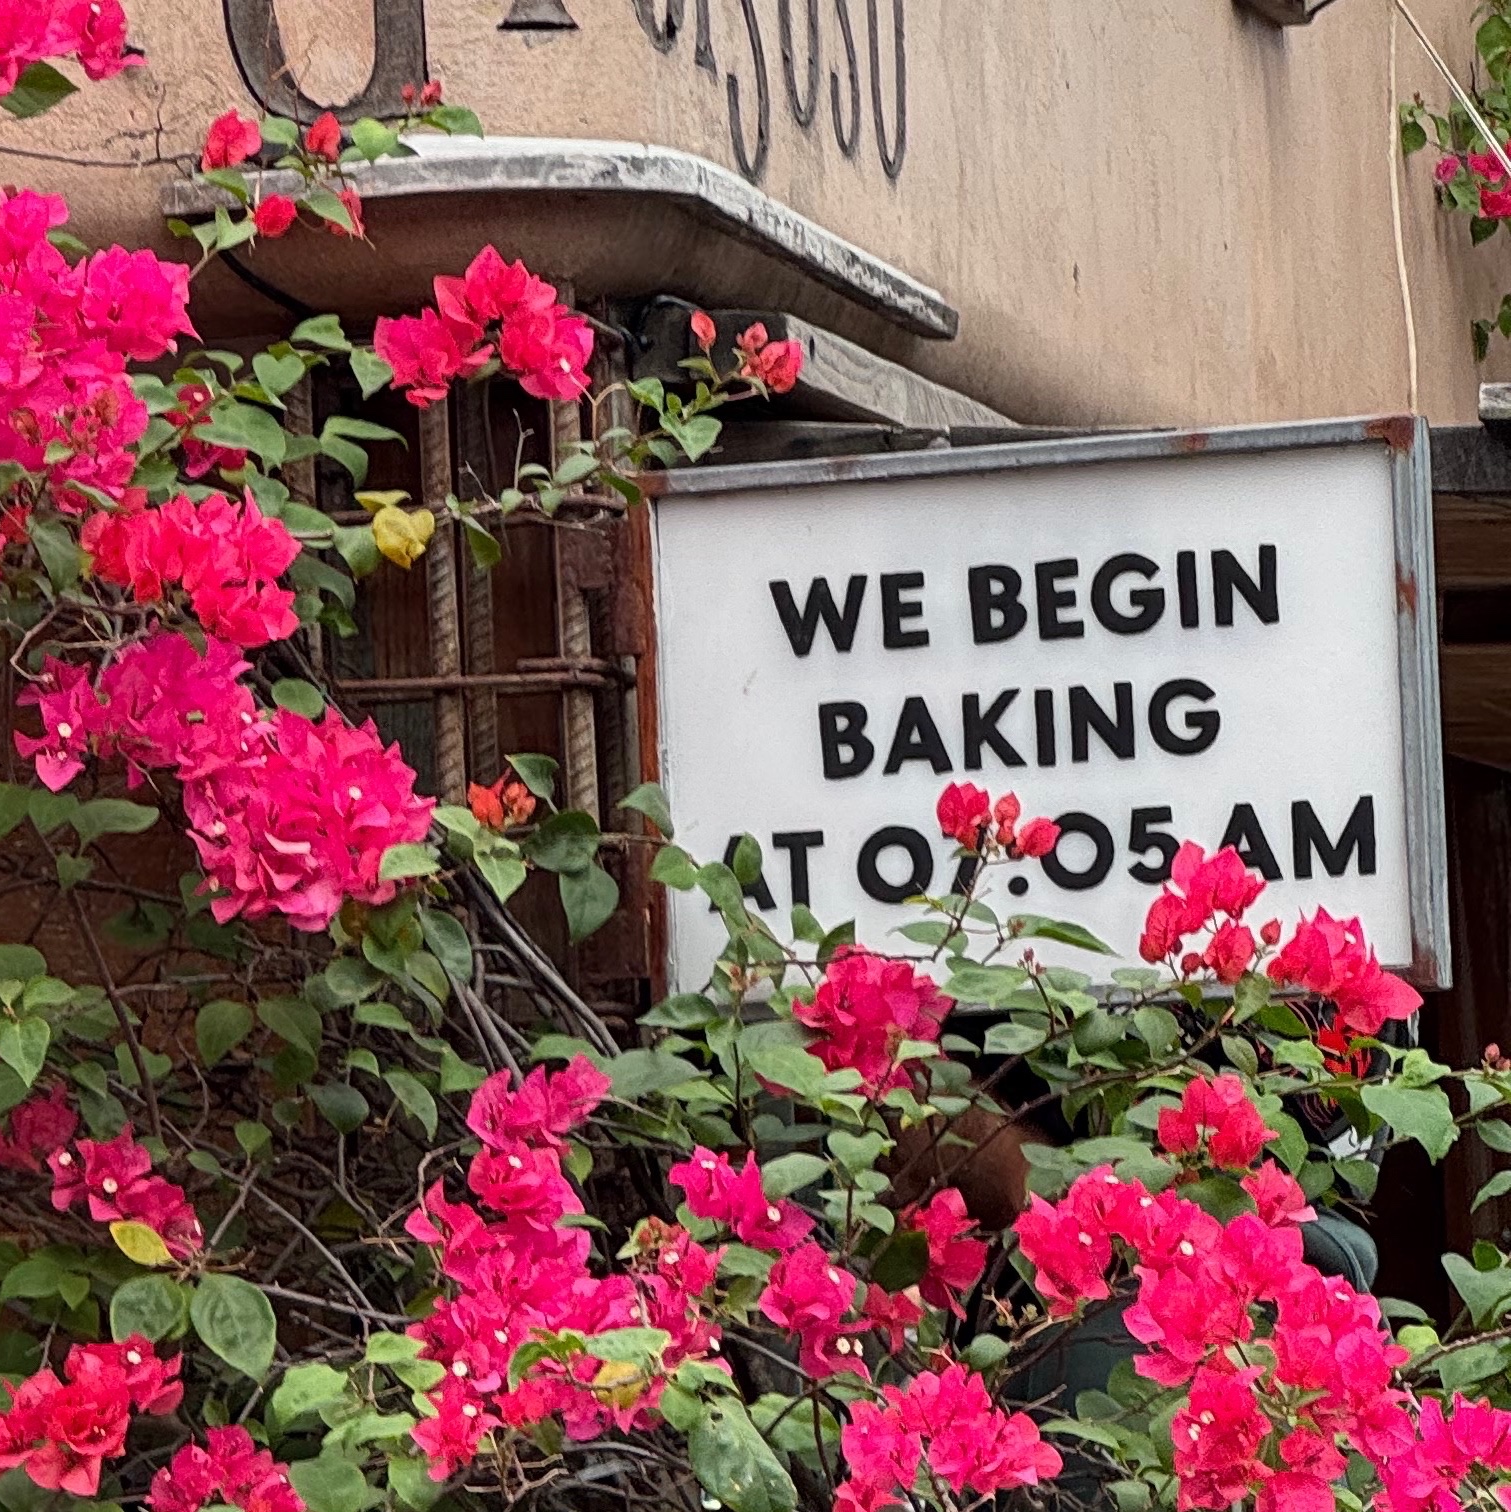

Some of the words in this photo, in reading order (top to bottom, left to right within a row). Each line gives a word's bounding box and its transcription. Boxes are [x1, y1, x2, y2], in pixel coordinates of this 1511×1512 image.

[769, 571, 930, 657] WE
[967, 544, 1280, 645] BEGIN
[818, 678, 1221, 780] BAKING
[1217, 794, 1377, 881] AM
